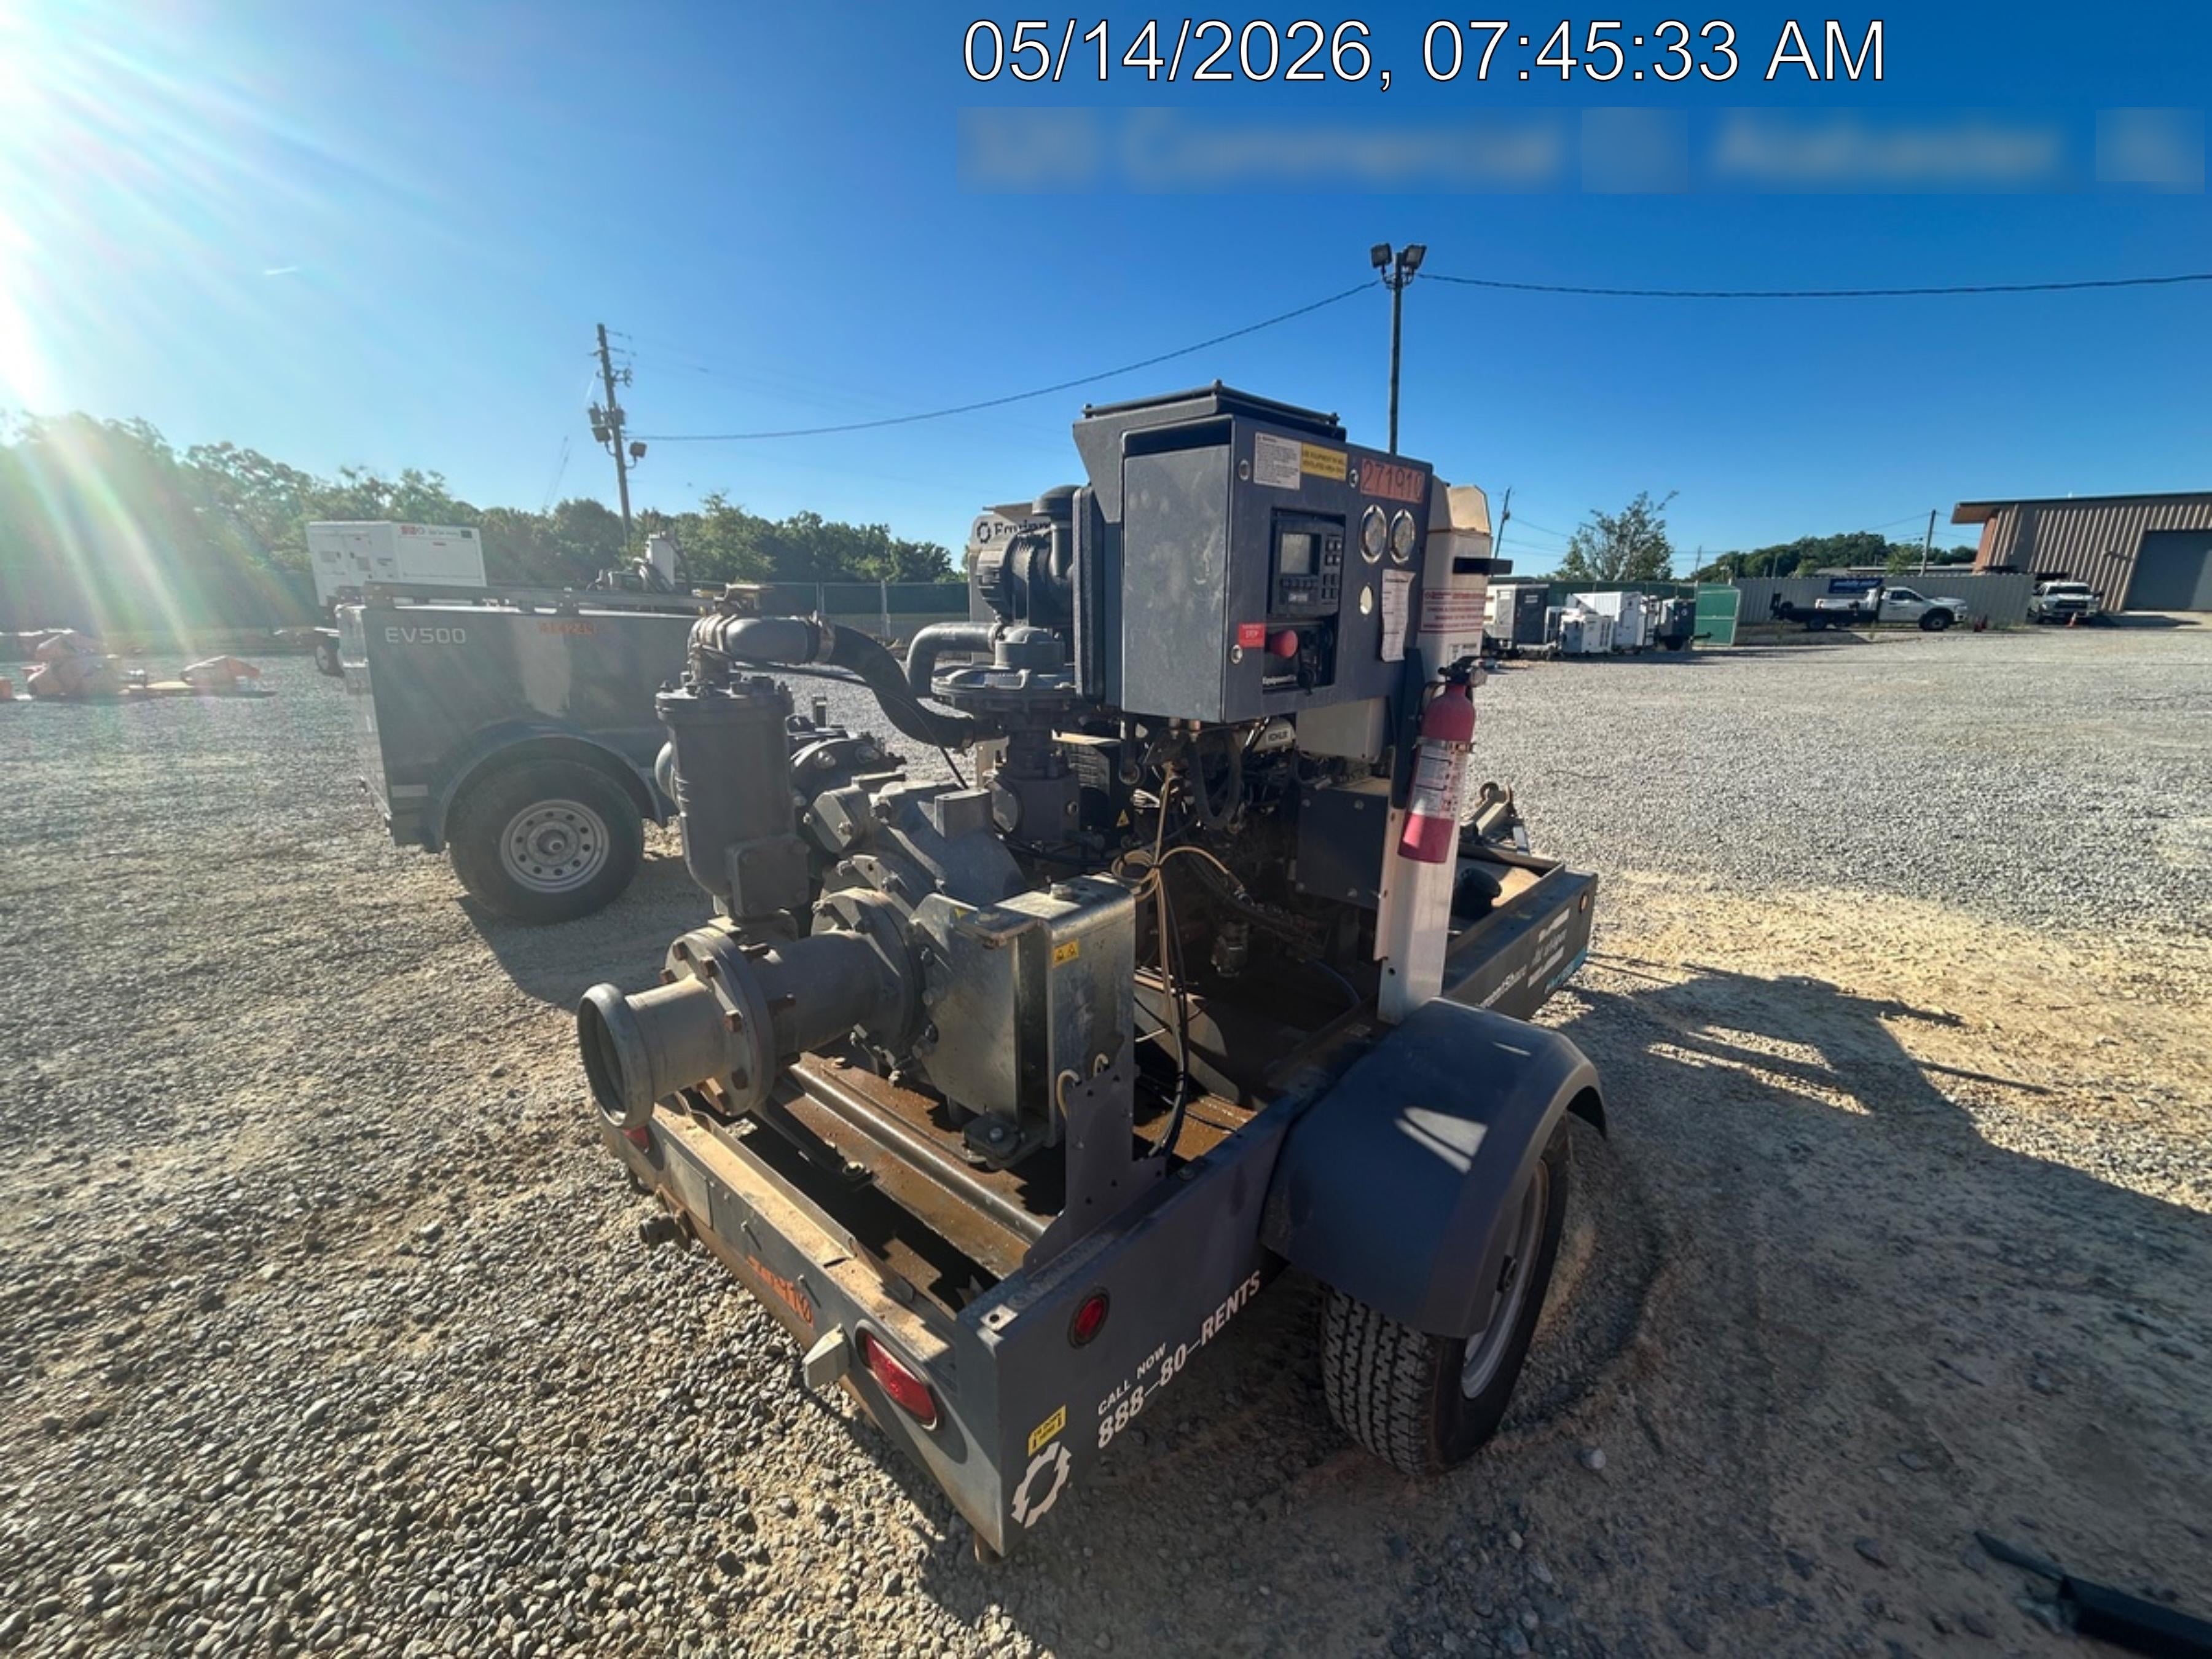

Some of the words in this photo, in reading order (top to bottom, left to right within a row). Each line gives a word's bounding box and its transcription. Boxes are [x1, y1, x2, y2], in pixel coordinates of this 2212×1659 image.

[384, 626, 467, 645] EV500
[1097, 1269, 1260, 1449] 888-80-RENTS
[1097, 1379, 1131, 1416] CALL
[1137, 1342, 1166, 1379] NOW
